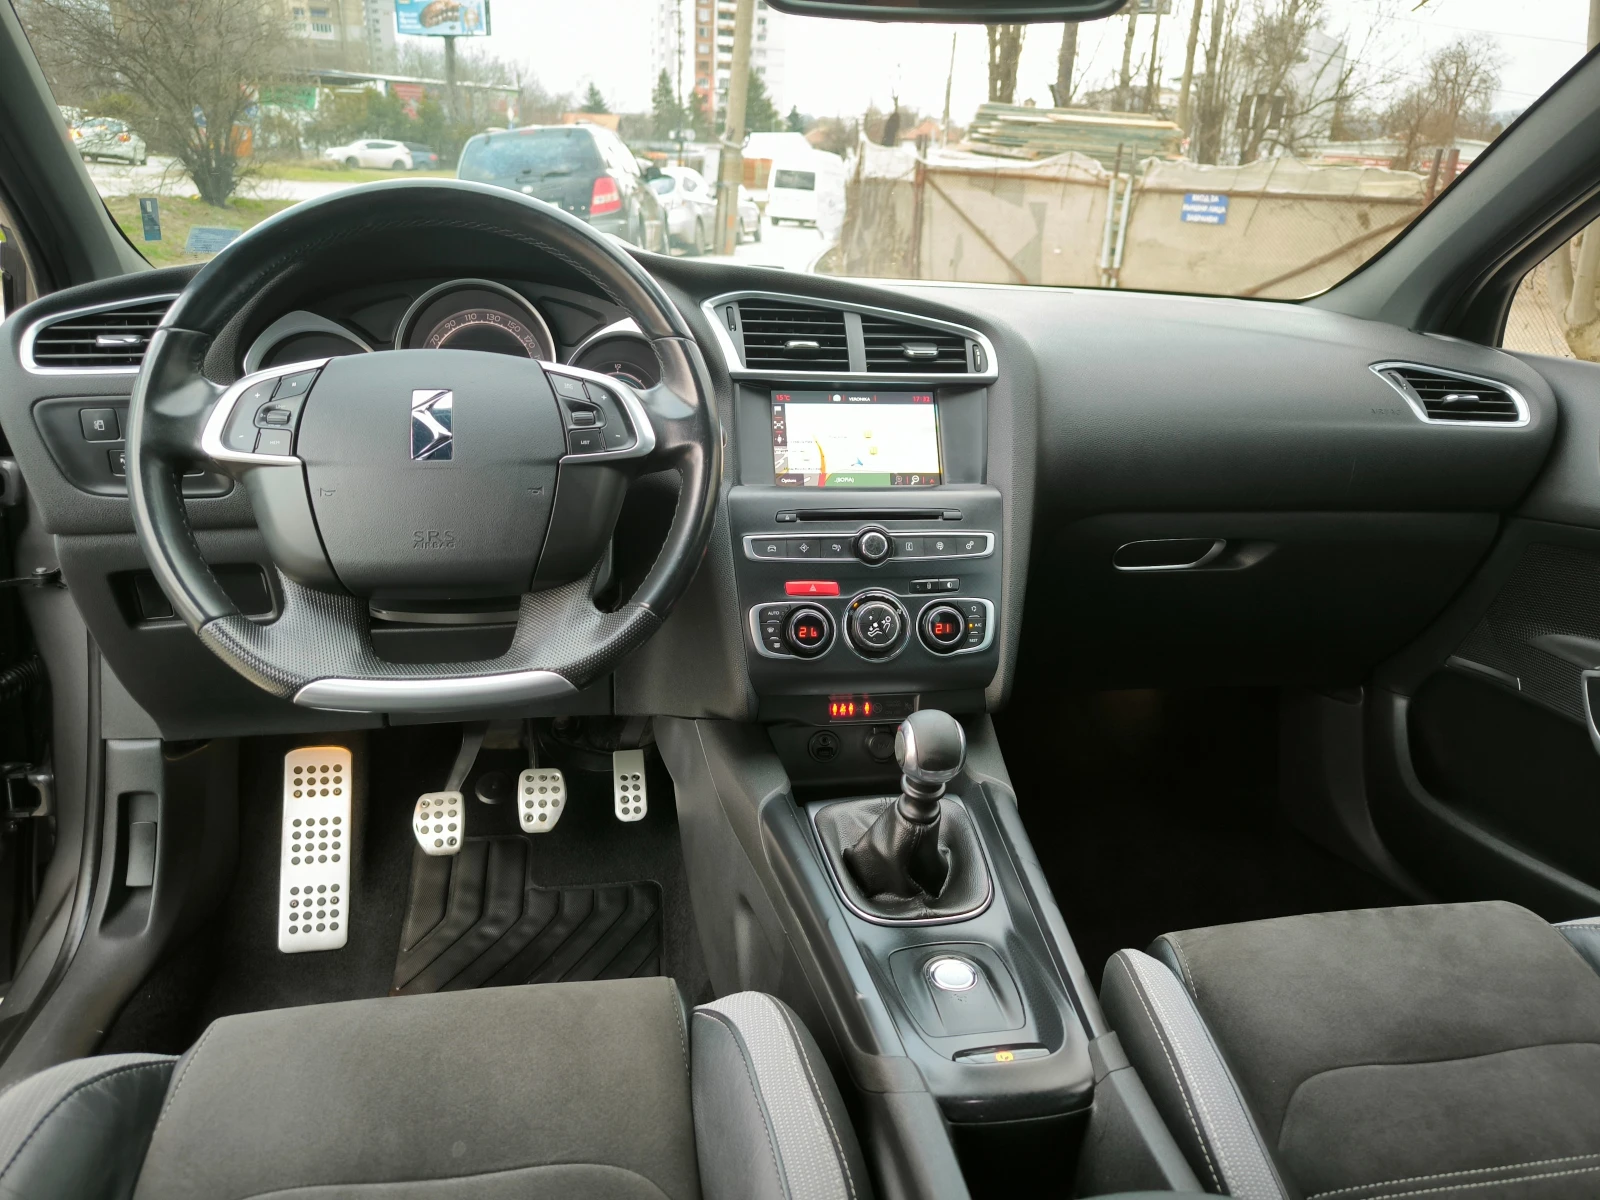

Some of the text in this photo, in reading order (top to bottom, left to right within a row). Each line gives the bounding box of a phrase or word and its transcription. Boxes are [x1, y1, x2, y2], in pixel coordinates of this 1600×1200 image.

[430, 312, 536, 349] 70 90 110 130 150 170
[412, 530, 455, 542] SRS
